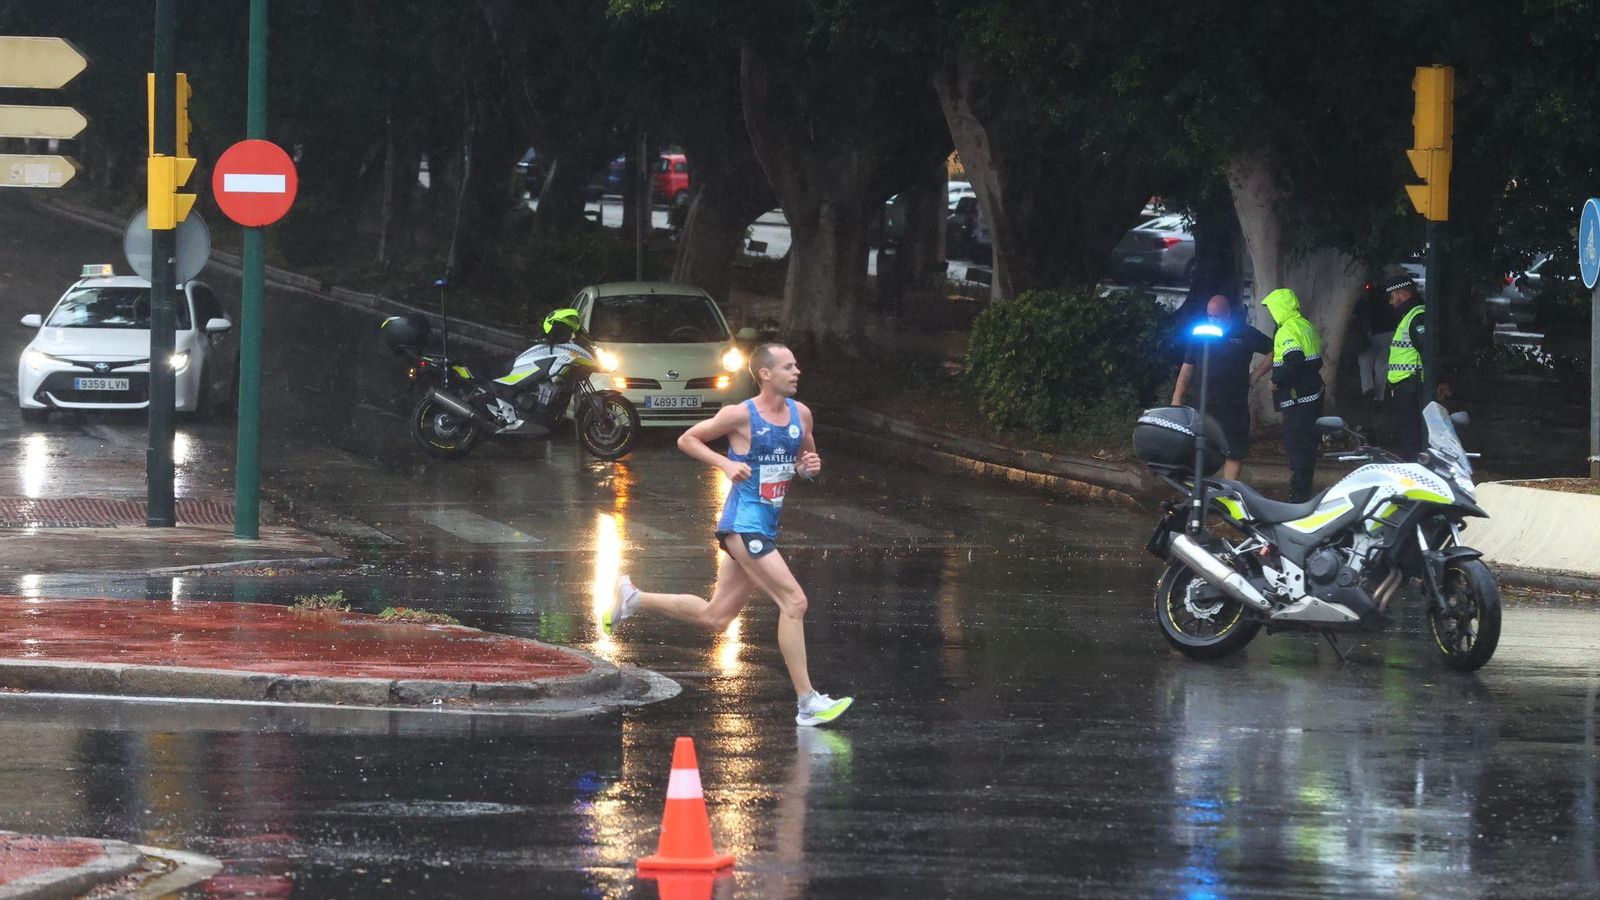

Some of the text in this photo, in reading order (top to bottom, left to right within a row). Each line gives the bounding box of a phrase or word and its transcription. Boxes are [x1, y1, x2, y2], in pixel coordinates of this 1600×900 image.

[81, 379, 128, 390] 9359 LVN
[654, 397, 698, 407] 4893 FCB
